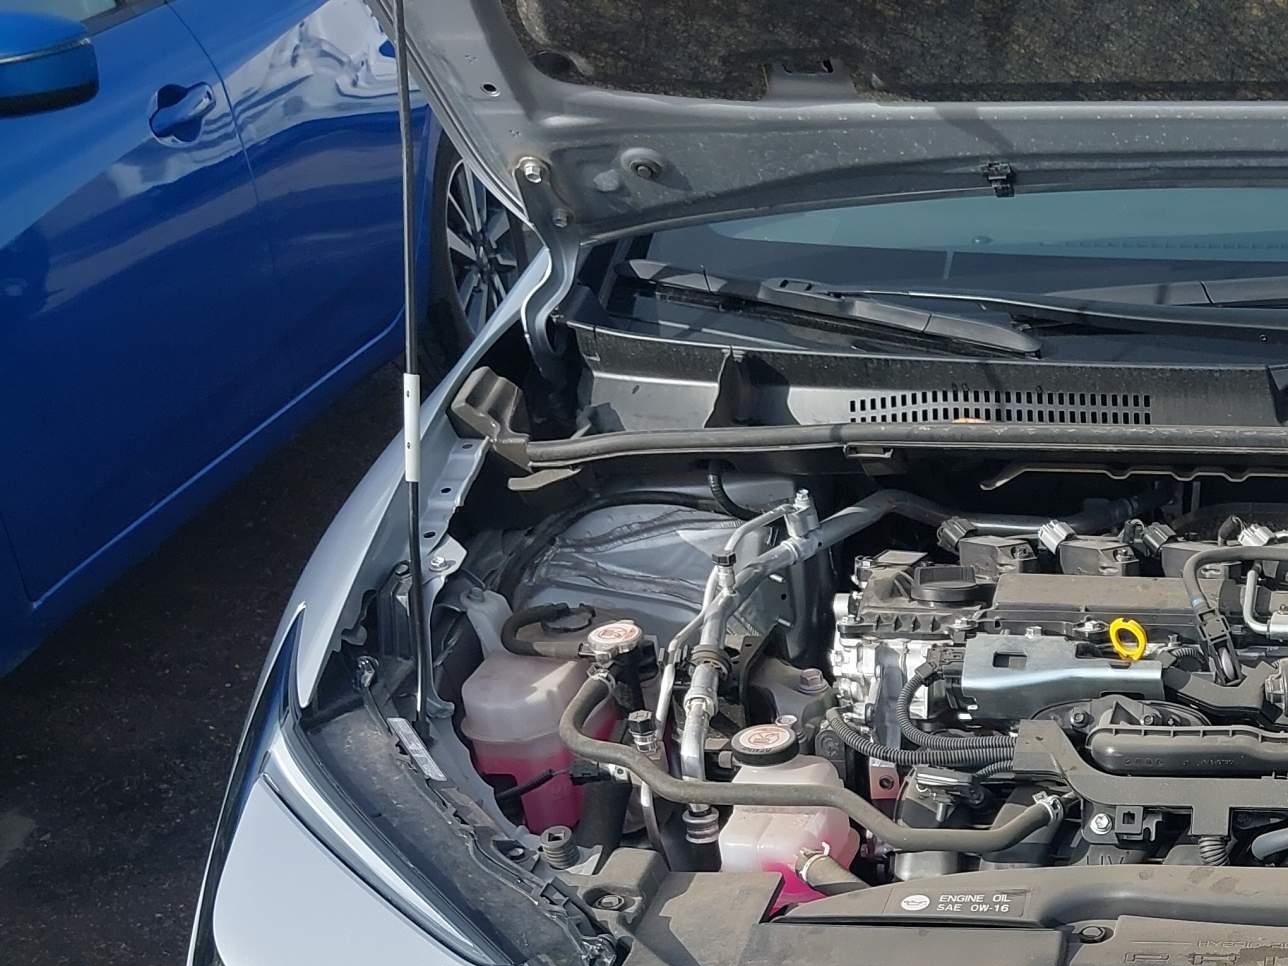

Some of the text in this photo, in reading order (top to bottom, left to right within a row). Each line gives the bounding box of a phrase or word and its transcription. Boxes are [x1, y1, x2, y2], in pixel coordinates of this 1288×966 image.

[939, 894, 1011, 903] ENGINE OIL
[936, 903, 962, 912] SAE
